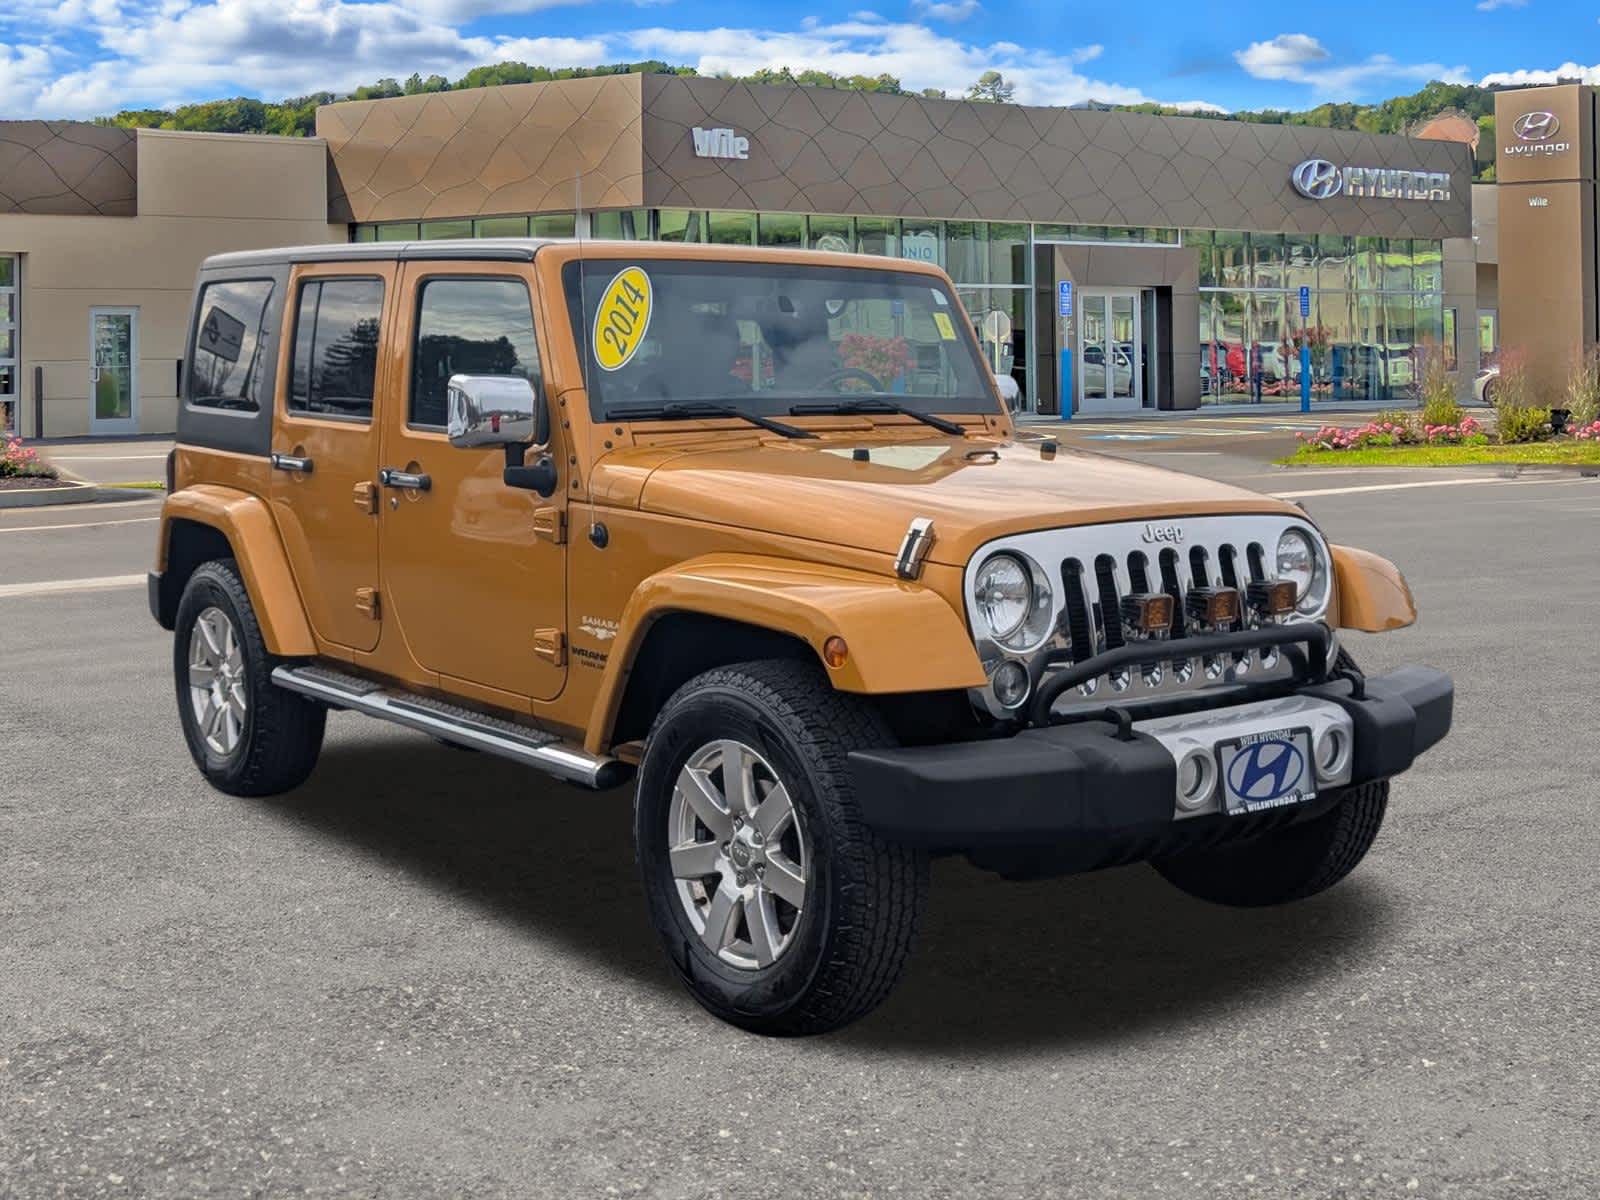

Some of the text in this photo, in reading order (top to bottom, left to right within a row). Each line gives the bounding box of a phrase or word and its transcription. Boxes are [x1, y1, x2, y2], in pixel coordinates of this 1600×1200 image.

[1342, 166, 1451, 201] HYUNDAI
[1527, 196, 1549, 208] Wile
[603, 279, 645, 357] 2014
[1142, 524, 1184, 545] Jeep
[581, 615, 619, 629] SAHARA
[1240, 728, 1293, 746] WILE HYUNDAI
